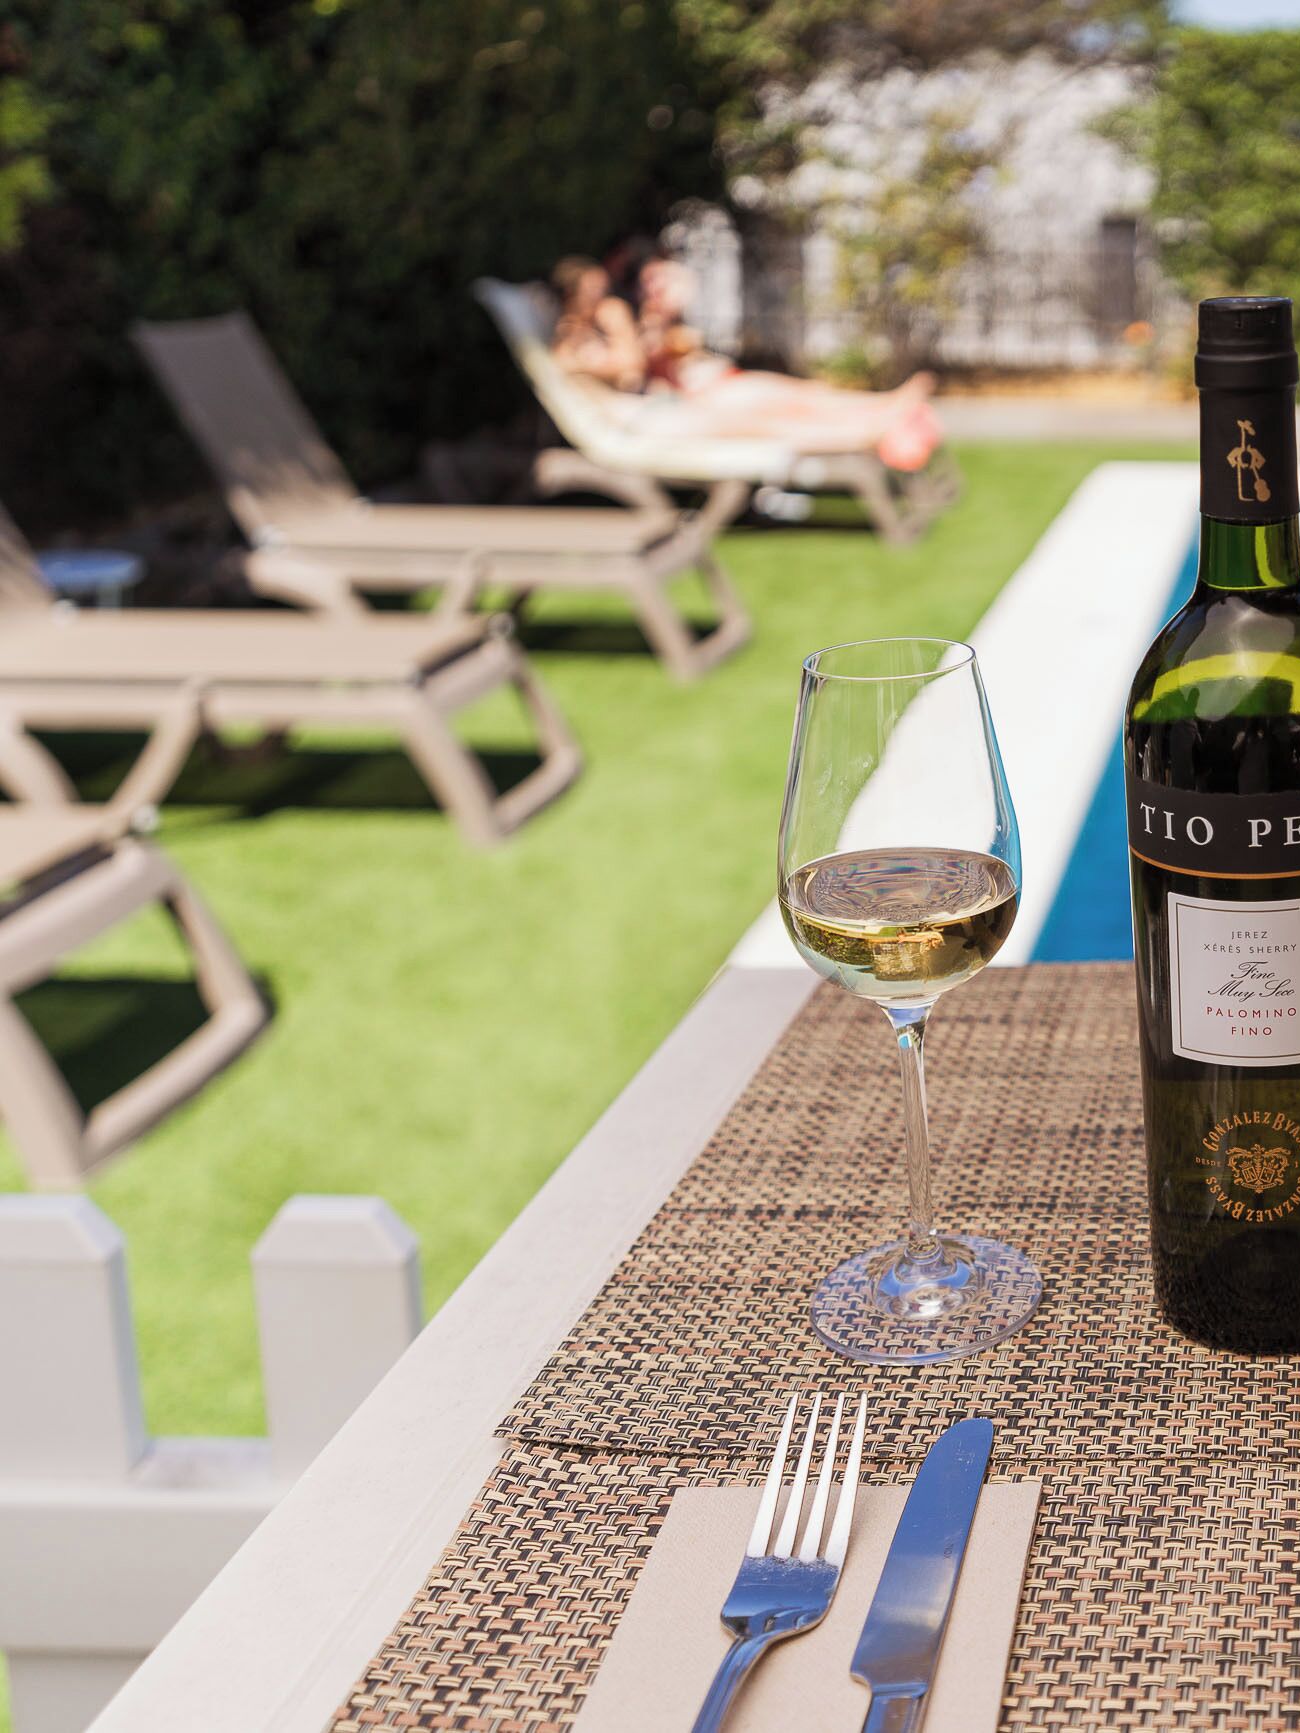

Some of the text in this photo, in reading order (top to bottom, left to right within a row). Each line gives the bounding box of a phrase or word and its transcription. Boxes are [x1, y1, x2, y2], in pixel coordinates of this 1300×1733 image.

[1140, 802, 1214, 846] TIO
[1231, 931, 1269, 940] JEREZ
[1203, 943, 1297, 954] XÉRÈS SHERRY
[1230, 961, 1276, 980] Fino
[1207, 979, 1296, 1003] Muy Seco
[1206, 1006, 1297, 1019] PALOMINO
[1231, 1026, 1273, 1036] FINO
[1202, 1111, 1272, 1152] GONZALEZ
[1205, 1176, 1247, 1221] BYASS
